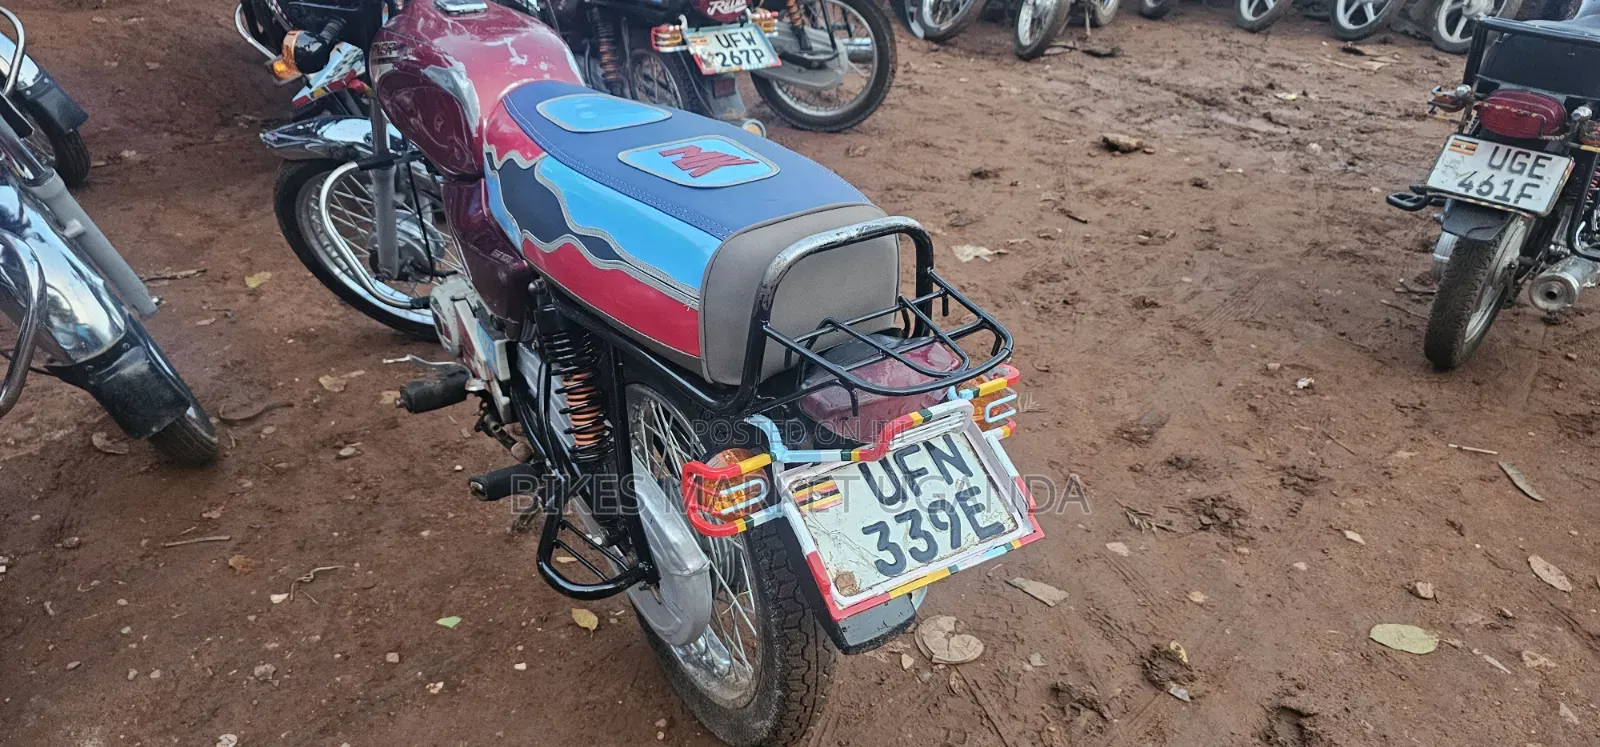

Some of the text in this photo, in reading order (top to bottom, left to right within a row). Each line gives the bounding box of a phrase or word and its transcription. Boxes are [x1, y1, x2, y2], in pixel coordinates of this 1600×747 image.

[715, 31, 757, 49] UFW
[715, 48, 765, 67] 267P
[1487, 145, 1553, 180] UGE
[1457, 170, 1541, 205] 461F
[858, 433, 974, 506] UFN
[861, 485, 1006, 577] 339E
